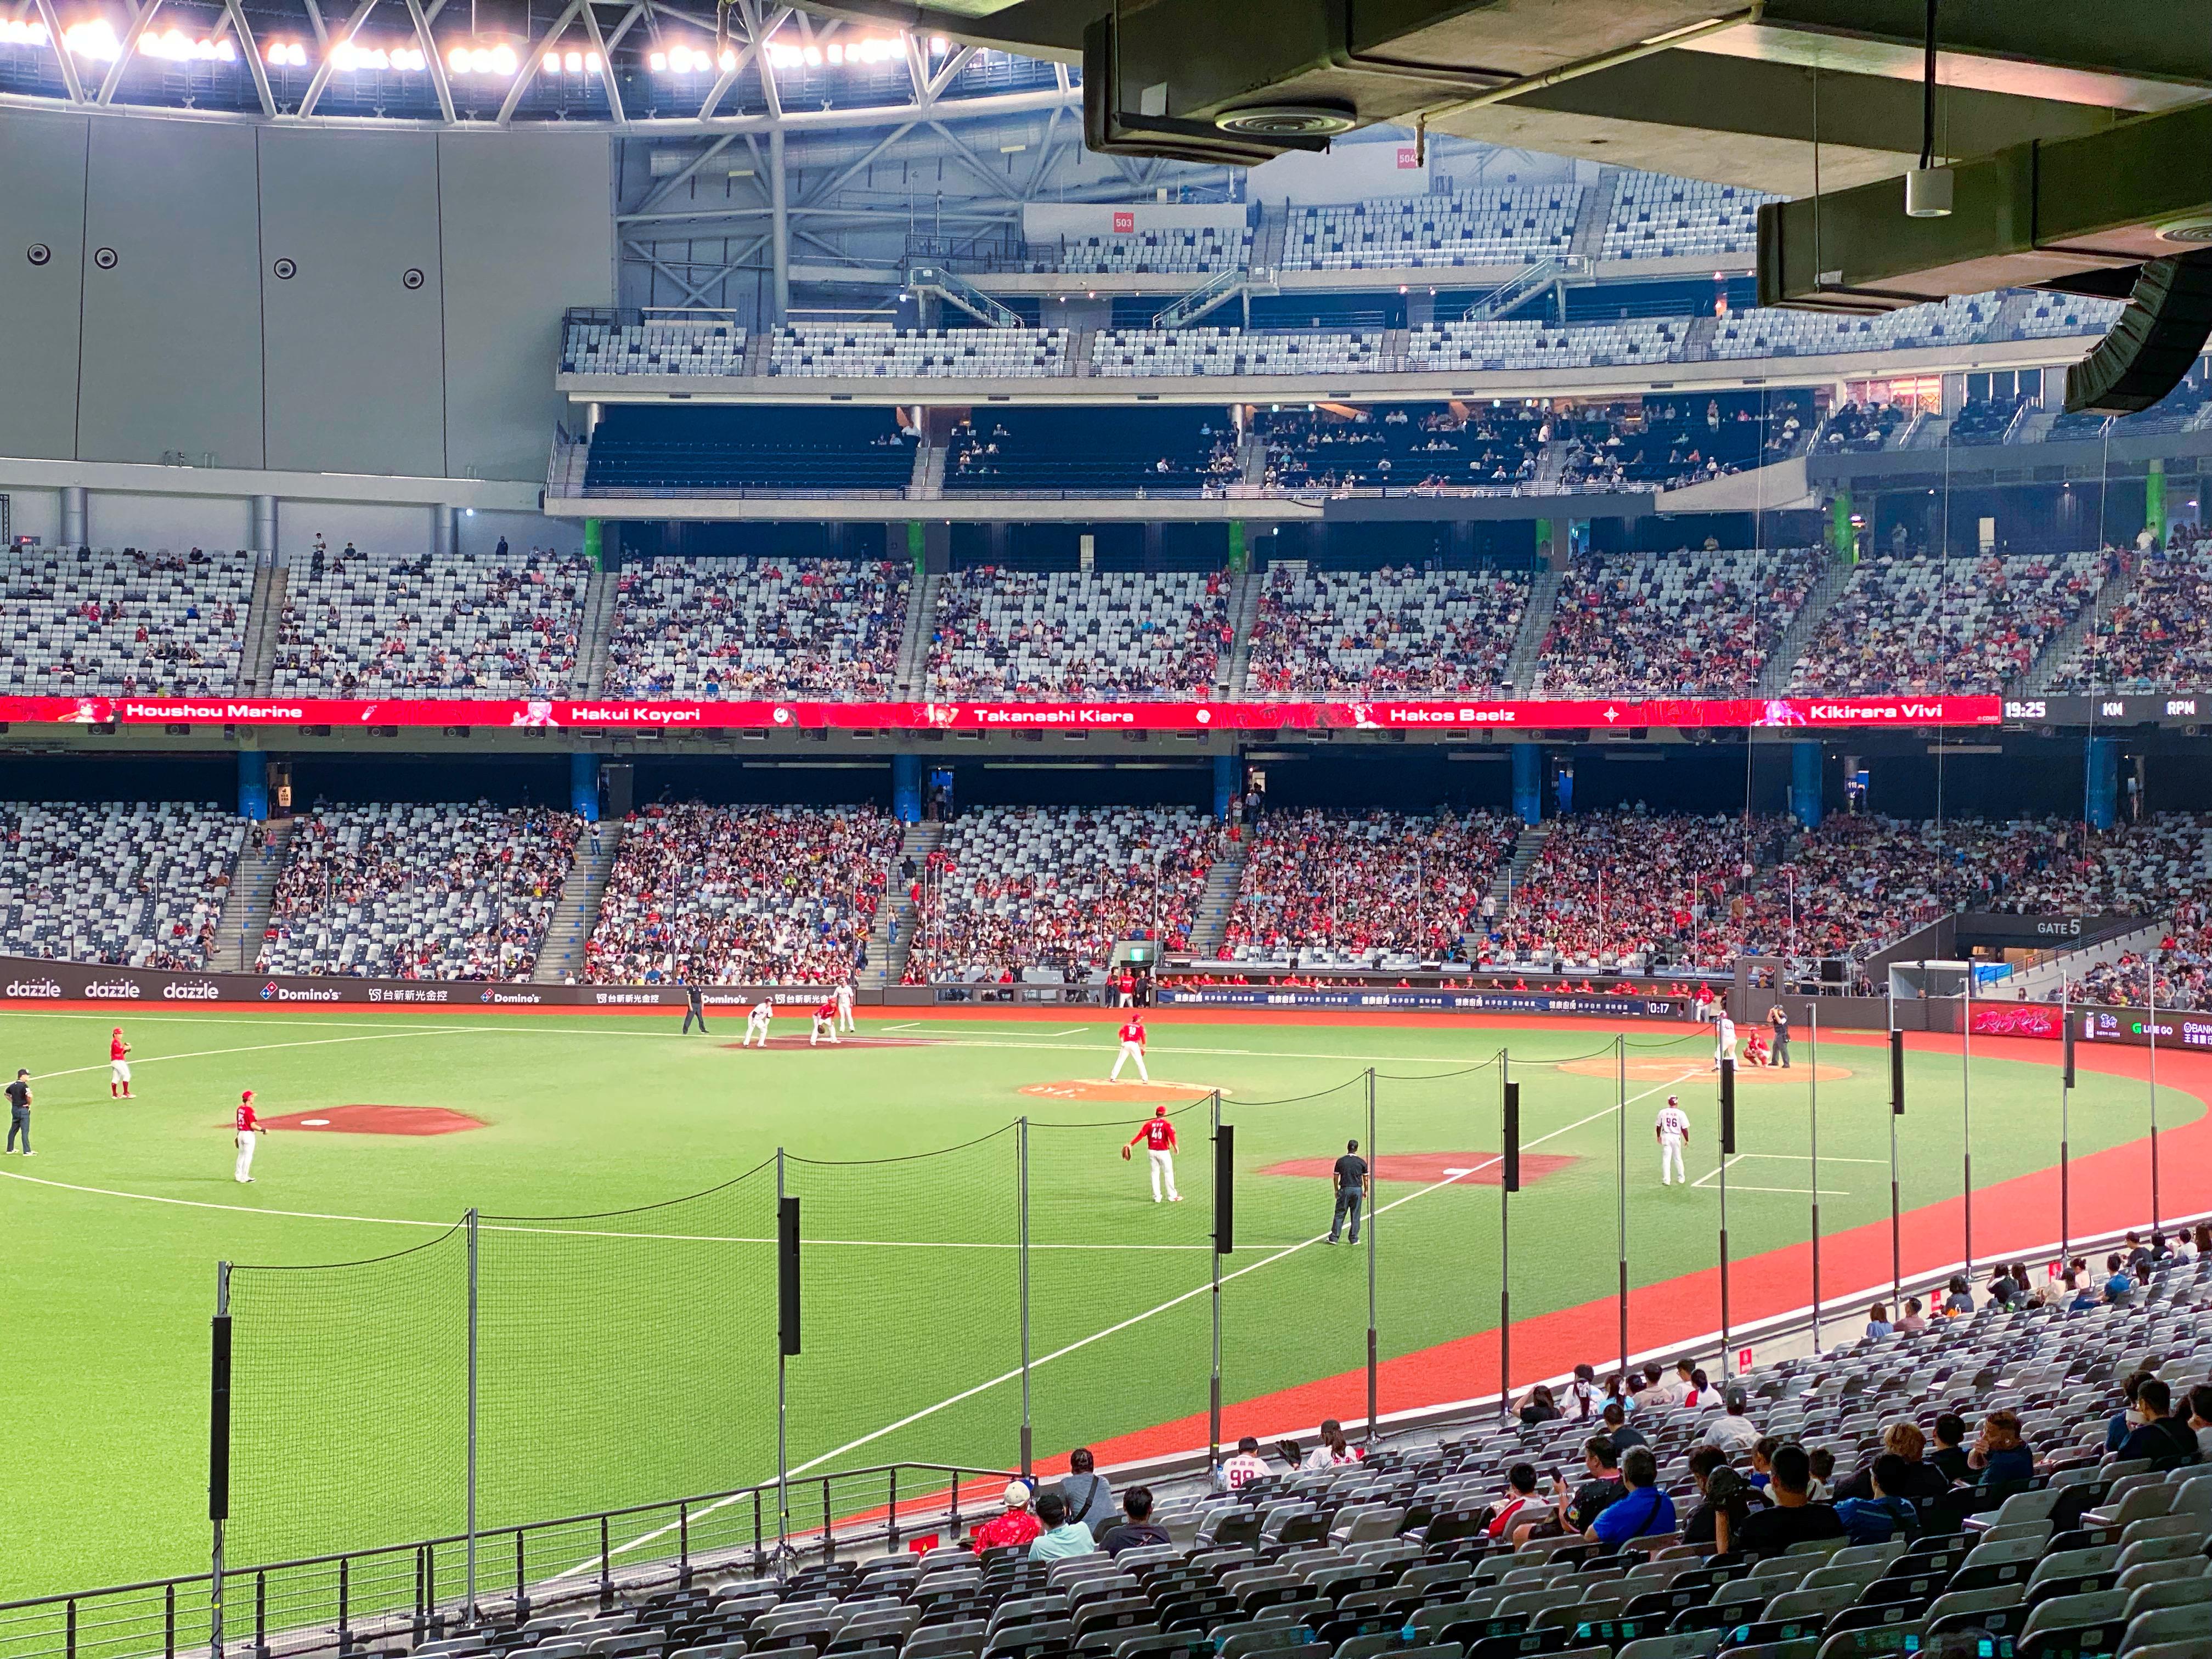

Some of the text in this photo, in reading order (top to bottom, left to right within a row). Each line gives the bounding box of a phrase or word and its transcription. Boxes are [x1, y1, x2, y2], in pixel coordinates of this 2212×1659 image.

[1116, 218, 1132, 228] 503
[127, 704, 302, 718] Houshou Marine
[1391, 708, 1515, 721] Hakos Baelz
[1811, 704, 1942, 719] Kikirara Vivi
[2005, 702, 2046, 717] 19:25
[2102, 702, 2123, 716] KM
[2167, 701, 2195, 715] RPM
[572, 708, 699, 724] Hakui Koyori
[974, 709, 1133, 722] Takanashi Kiara
[2038, 919, 2080, 935] GATE 5
[6, 980, 61, 998] dazzle
[85, 981, 140, 998] dazzle
[163, 982, 219, 1000] dazzle
[279, 988, 339, 1001] Domino's
[383, 989, 448, 1002] 台新新光金控
[494, 994, 540, 1003] Domino's
[608, 994, 659, 1003] 台新新光金控
[703, 995, 747, 1004] Domino's
[1649, 1003, 1669, 1013] 0:17
[2160, 1026, 2173, 1035] GO
[1666, 1118, 1677, 1127] 96
